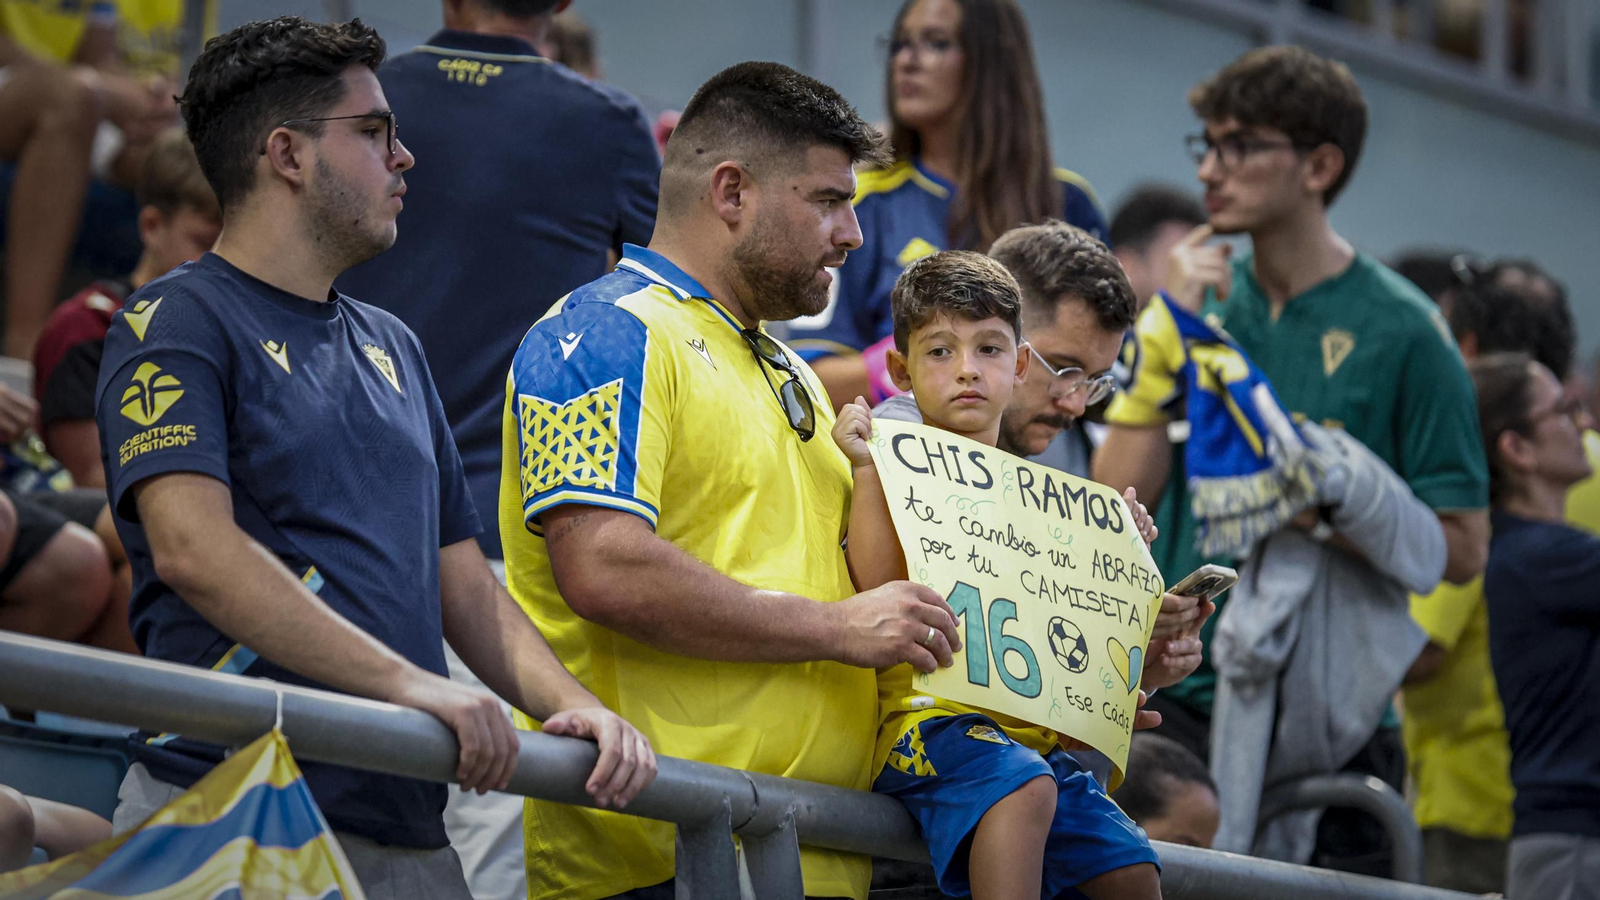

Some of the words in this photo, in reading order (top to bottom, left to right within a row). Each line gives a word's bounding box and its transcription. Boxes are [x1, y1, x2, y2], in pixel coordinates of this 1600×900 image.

[119, 424, 197, 457] SCIENTIFFIC
[120, 435, 188, 468] NUTRITION
[891, 432, 994, 490] CHIS
[1016, 466, 1124, 534] RAMOS
[904, 485, 943, 525] te
[958, 515, 1041, 558] cambio
[1047, 548, 1077, 570] un
[1091, 548, 1163, 599] ABRAZO
[919, 536, 956, 564] por
[966, 544, 1000, 578] tu
[945, 580, 1042, 699] 16
[1064, 686, 1094, 714] Ese
